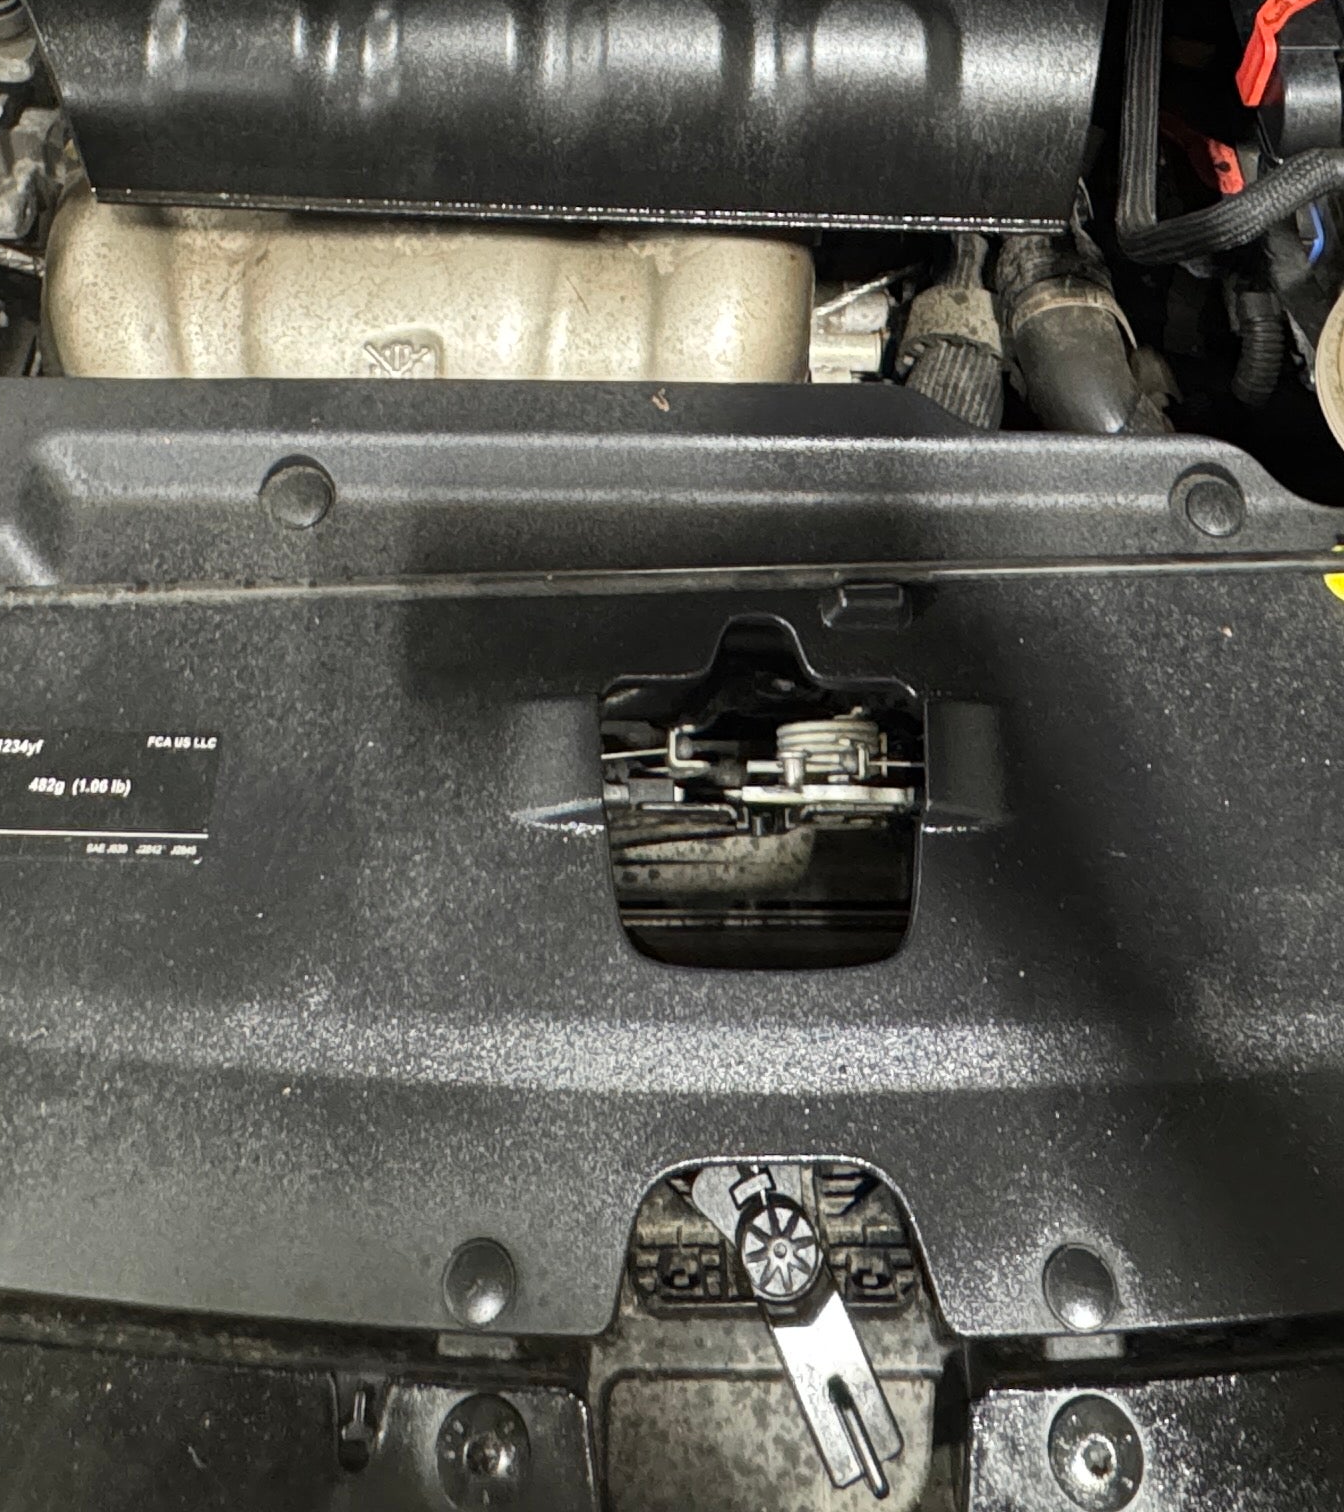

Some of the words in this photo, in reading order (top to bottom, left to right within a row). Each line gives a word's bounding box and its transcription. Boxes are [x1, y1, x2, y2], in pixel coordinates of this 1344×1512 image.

[146, 735, 172, 748] FCA
[174, 736, 191, 749] US
[193, 737, 218, 750] LLC
[28, 776, 66, 796] 482g
[110, 778, 132, 798] lb)
